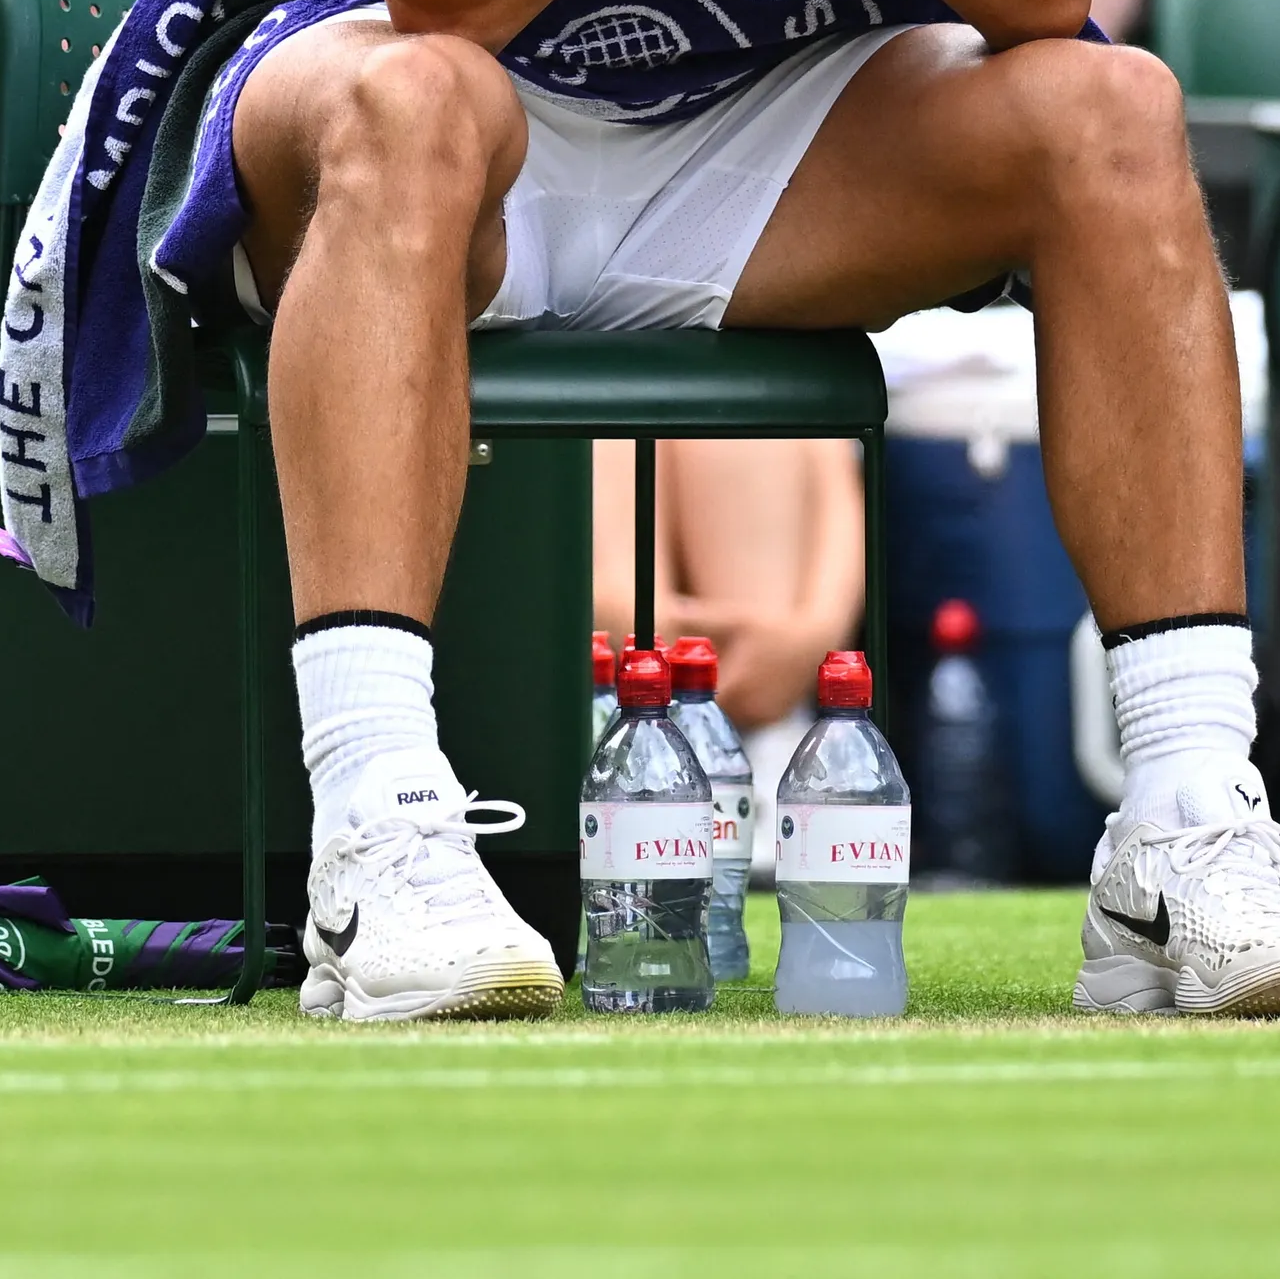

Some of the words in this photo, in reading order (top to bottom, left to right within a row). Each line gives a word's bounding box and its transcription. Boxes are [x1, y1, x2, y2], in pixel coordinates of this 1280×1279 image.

[397, 789, 439, 805] RAFA
[635, 838, 708, 861] EVIAN
[830, 841, 904, 863] EVIAN
